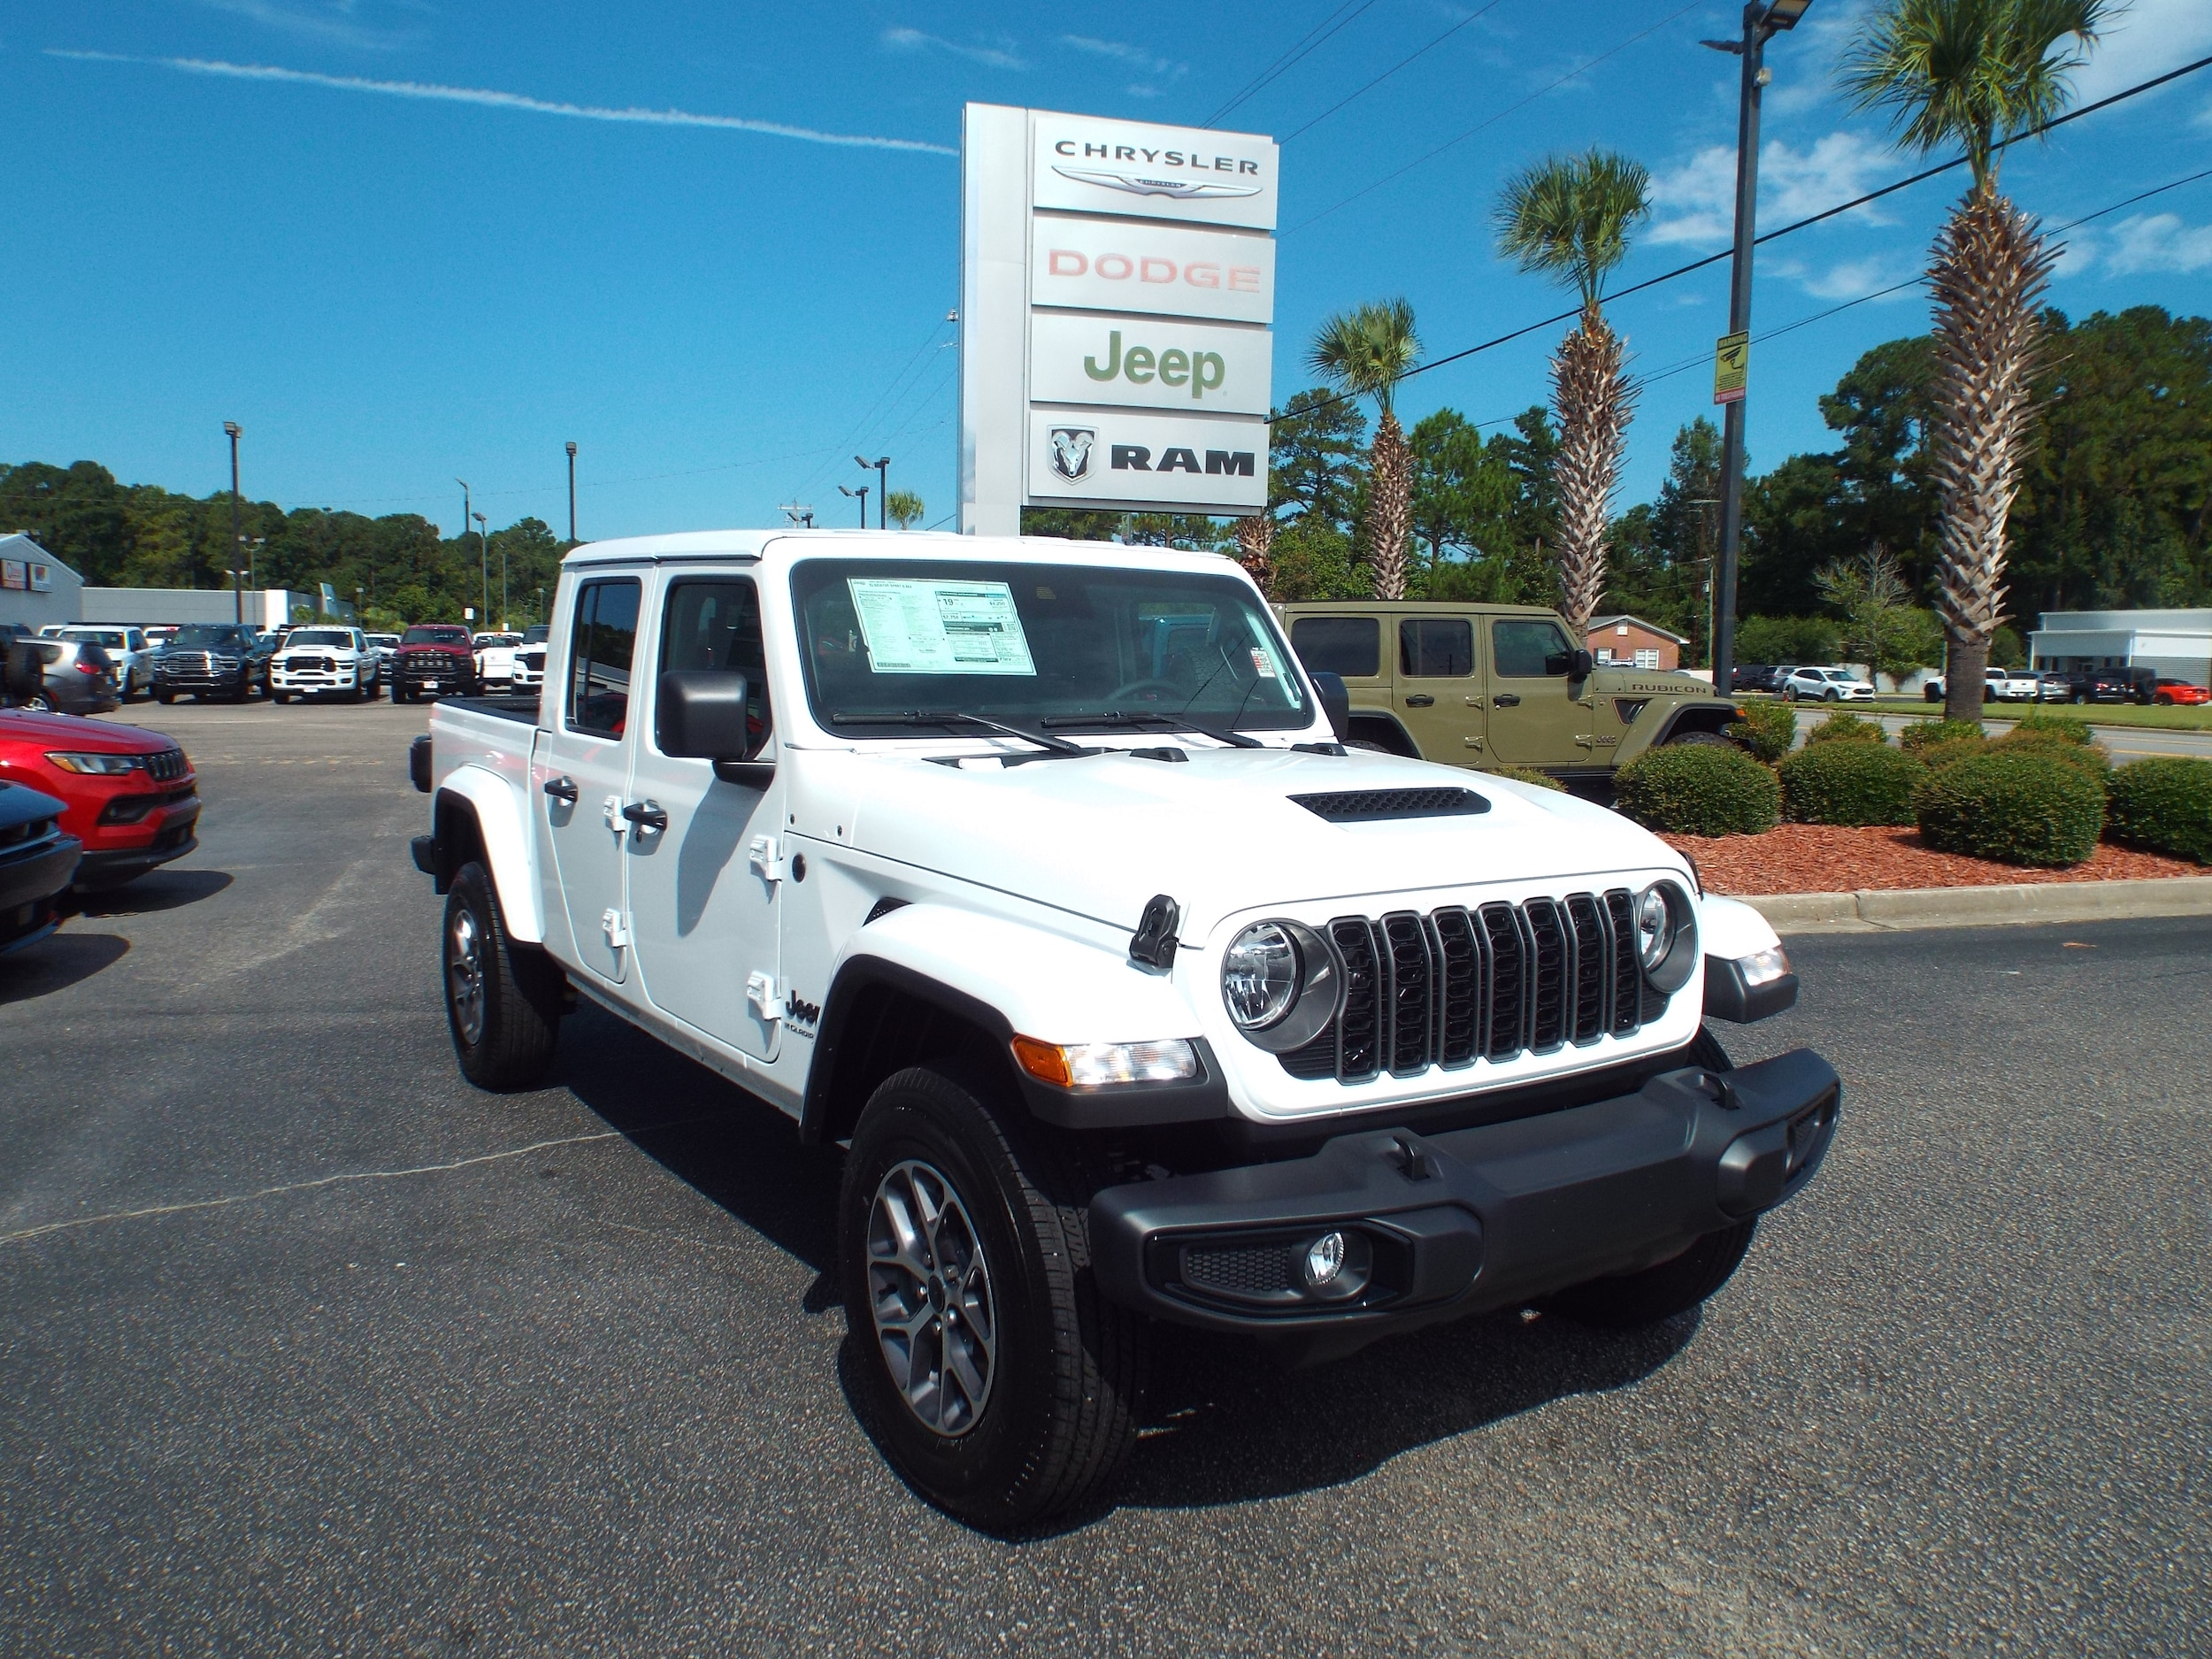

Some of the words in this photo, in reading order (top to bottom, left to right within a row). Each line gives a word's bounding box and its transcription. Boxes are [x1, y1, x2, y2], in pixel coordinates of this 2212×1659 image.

[1055, 140, 1259, 175] CHRYSLER
[1048, 249, 1261, 294] DODGE
[1084, 330, 1225, 399] Jeep
[1110, 444, 1255, 477] RAM
[1632, 684, 1706, 694] RUBICON
